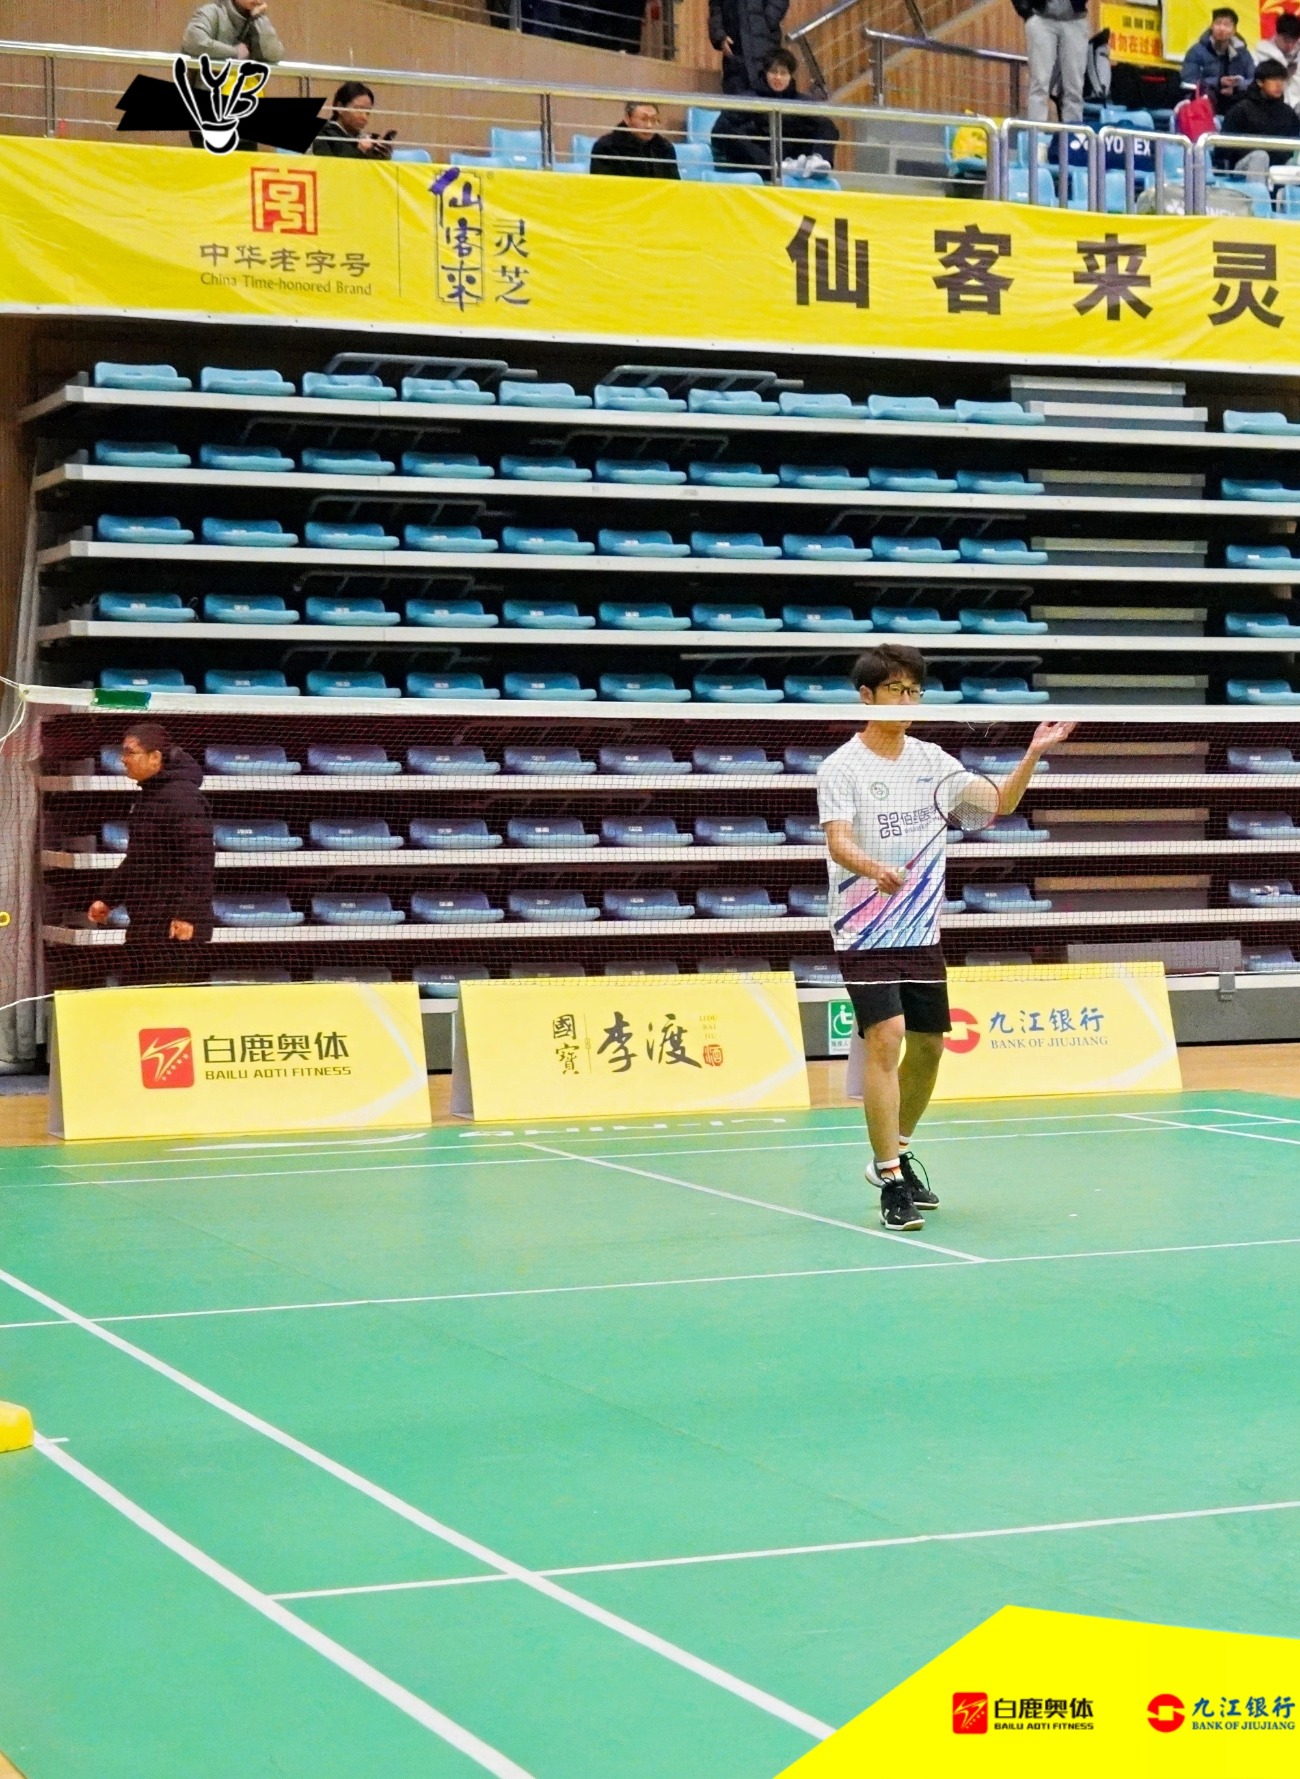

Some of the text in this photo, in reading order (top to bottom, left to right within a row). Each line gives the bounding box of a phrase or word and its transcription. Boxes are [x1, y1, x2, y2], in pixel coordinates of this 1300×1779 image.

[1105, 135, 1150, 156] YOEX
[199, 243, 371, 278] 中华老字号
[492, 218, 531, 305] 灵芝
[200, 272, 372, 296] China Time-honored Brand
[989, 1007, 1105, 1035] 九江银行
[203, 1030, 351, 1064] 白鹿奥体
[596, 1011, 703, 1074] 李渡
[990, 1036, 1109, 1049] BANK OF JIUJIANG
[205, 1069, 248, 1081] BAILU
[292, 1065, 352, 1078] FITNESS
